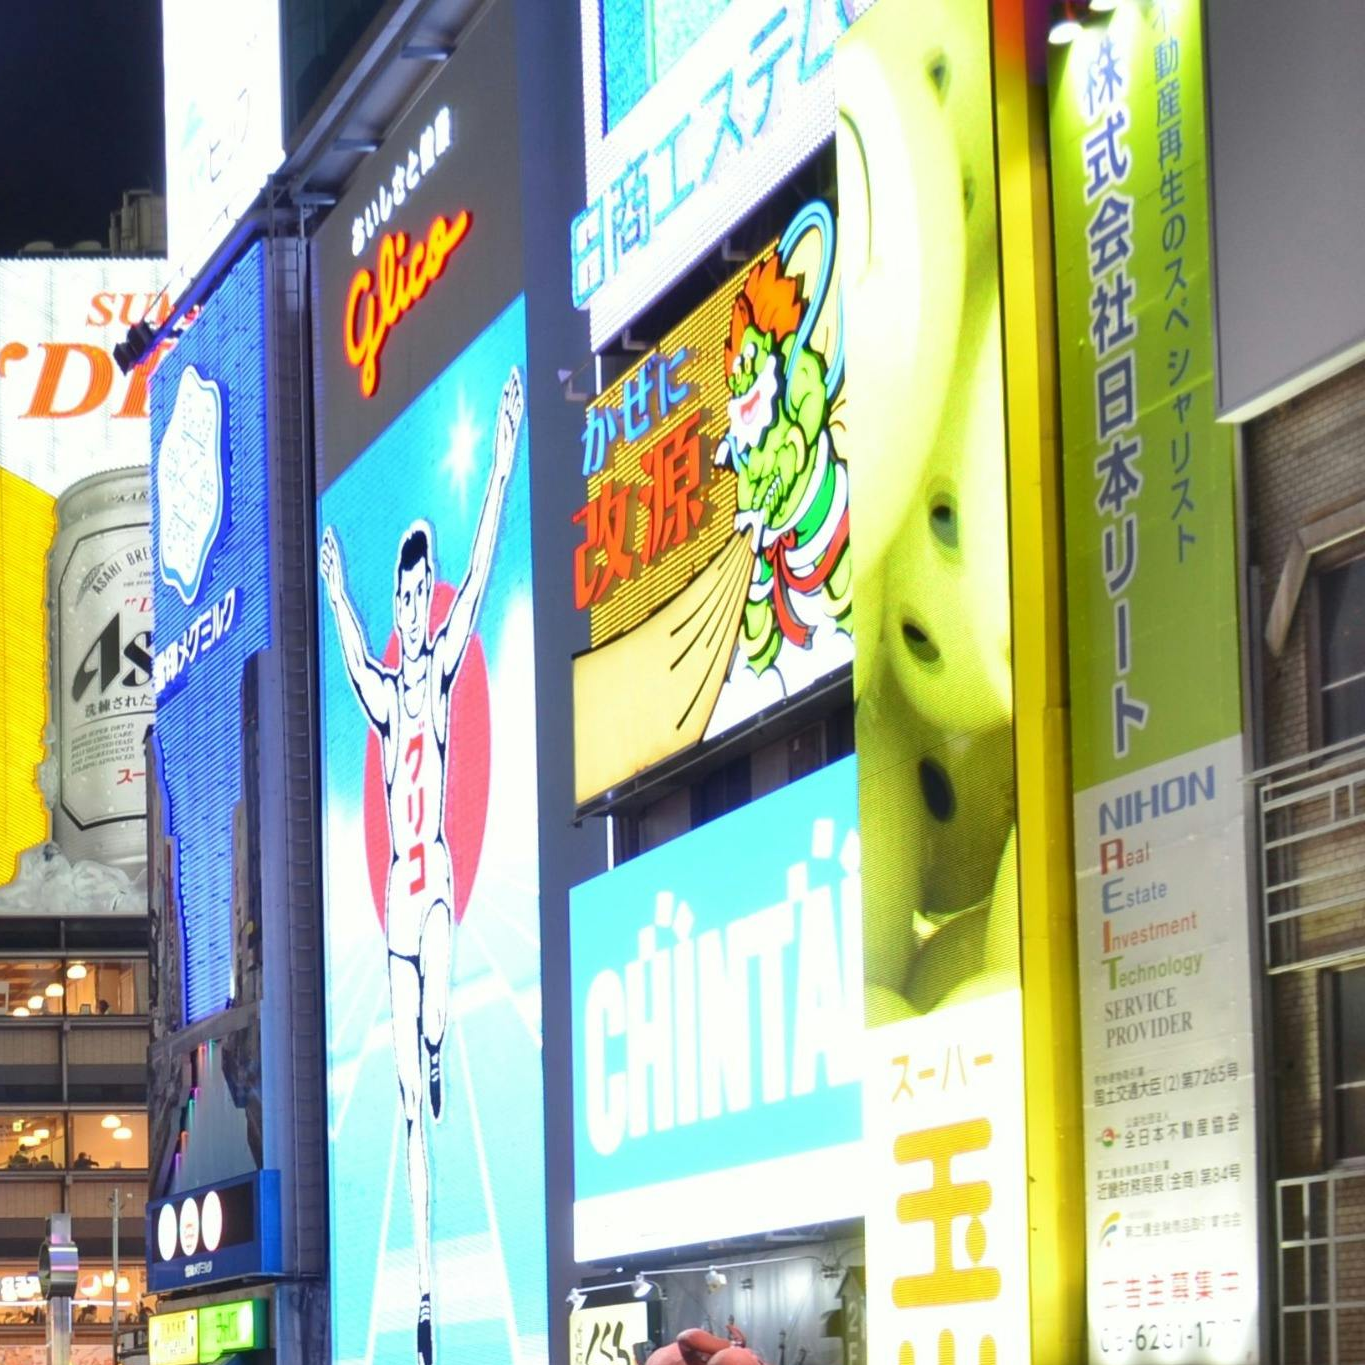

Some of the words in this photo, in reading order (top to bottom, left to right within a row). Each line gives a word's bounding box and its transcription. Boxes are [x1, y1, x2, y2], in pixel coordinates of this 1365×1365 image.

[351, 106, 452, 257] おいしさと健康
[343, 208, 473, 398] Glico
[581, 346, 689, 477] かぜに
[1085, 36, 1147, 760] 株式会社日本リート
[571, 411, 705, 610] 改源
[91, 561, 123, 595] ASAHI
[404, 720, 426, 897] グリコ
[1098, 765, 1217, 836] NIHON
[1100, 836, 1150, 876] Real
[1102, 878, 1169, 914] Estate
[1103, 910, 1199, 955] Investment
[1103, 951, 1204, 993] Technology
[1103, 986, 1178, 1023] SERVICE
[1105, 1010, 1194, 1051] PROVIDER
